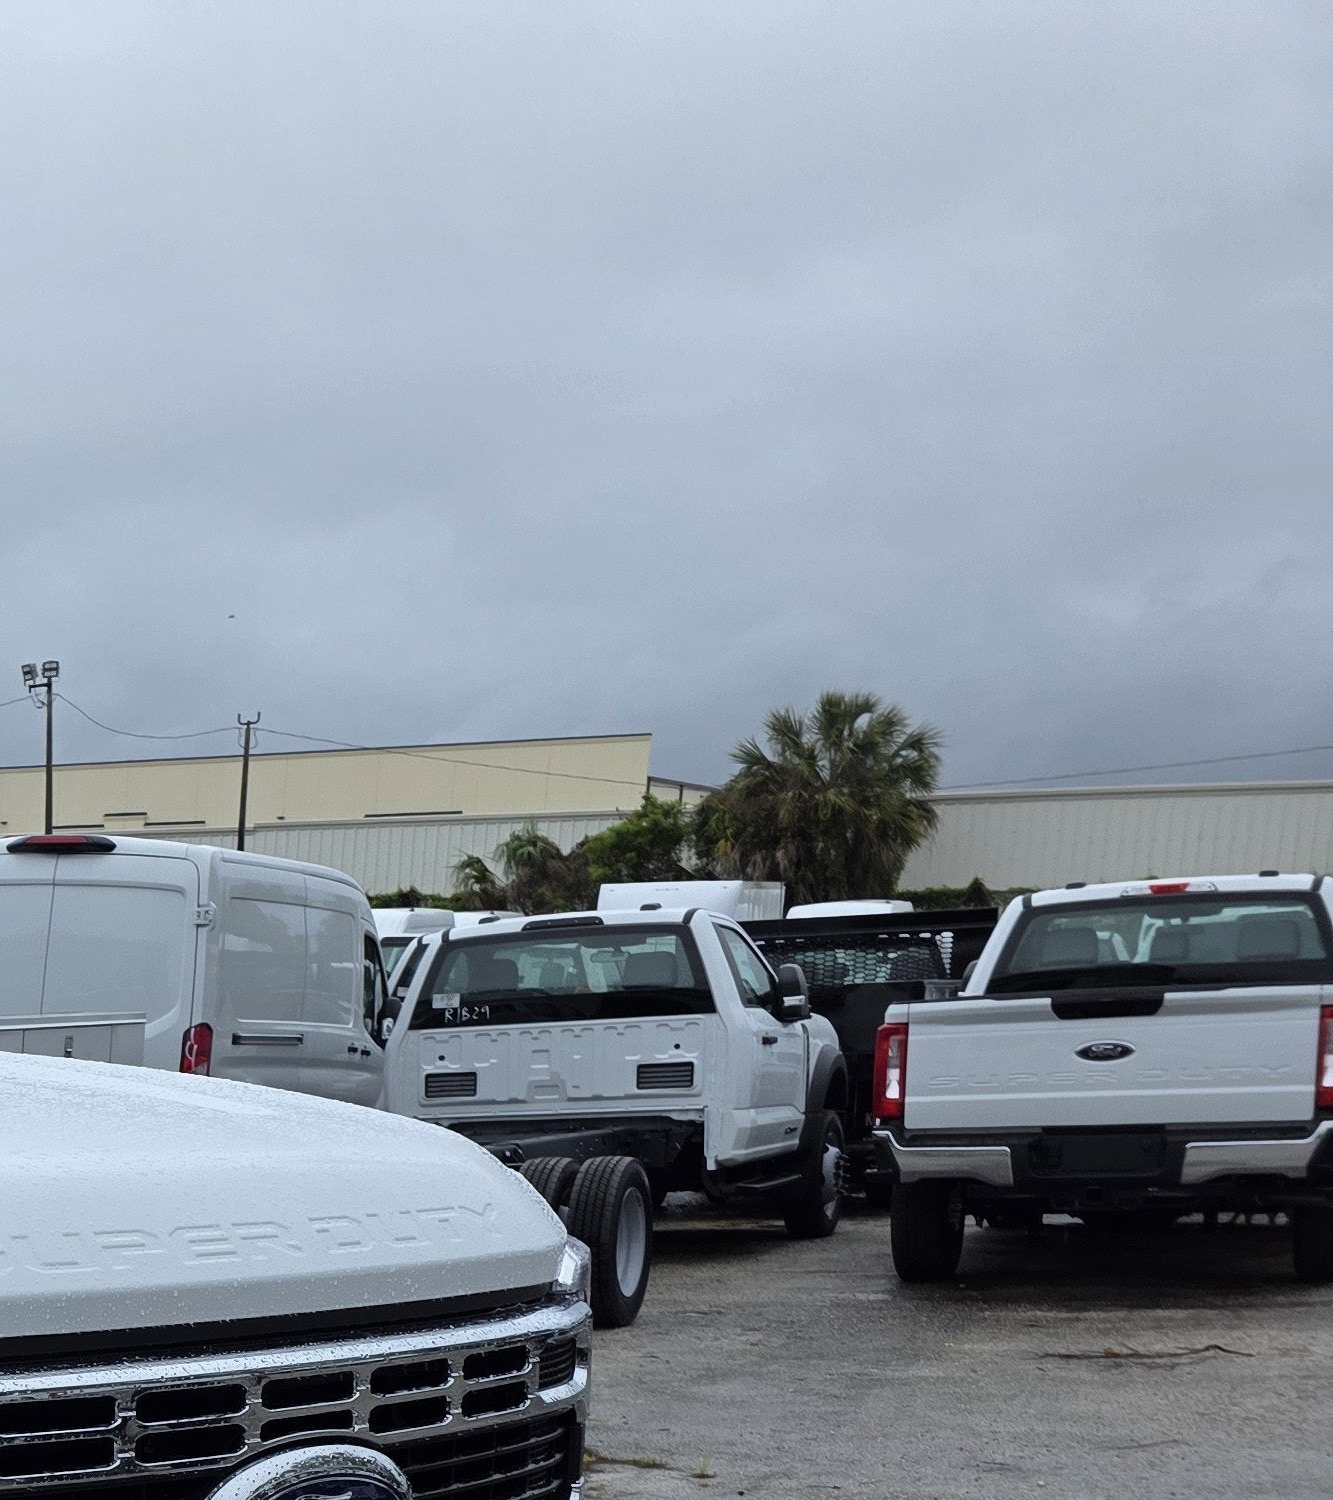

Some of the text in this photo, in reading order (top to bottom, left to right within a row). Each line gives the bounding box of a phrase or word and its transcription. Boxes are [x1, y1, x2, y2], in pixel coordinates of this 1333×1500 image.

[927, 1063, 1292, 1088] SUPER DUTY
[306, 1202, 499, 1255] DUTY
